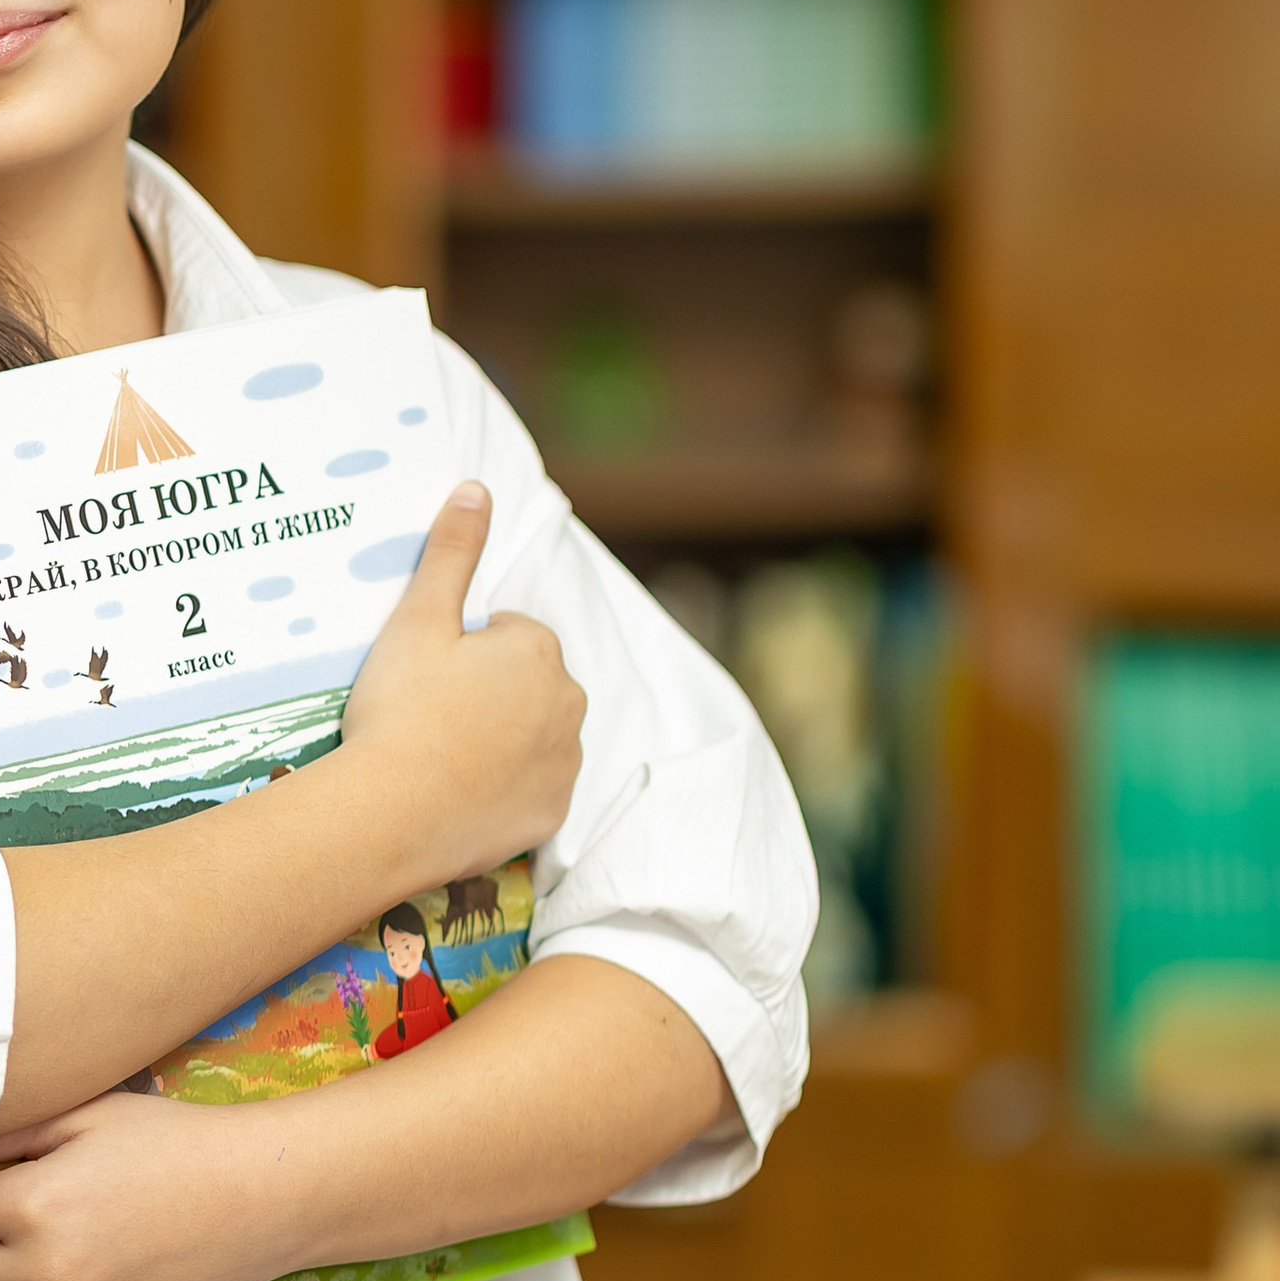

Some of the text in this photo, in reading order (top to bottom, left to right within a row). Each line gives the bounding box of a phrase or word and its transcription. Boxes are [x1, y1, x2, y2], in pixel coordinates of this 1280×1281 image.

[36, 461, 285, 546] МОЯ ЮГРА
[80, 558, 102, 583] В
[106, 526, 246, 578] КОТОРОМ
[251, 521, 271, 546] Я
[275, 502, 357, 543] ЖИВУ
[174, 592, 208, 638] 2
[166, 649, 237, 679] класс
